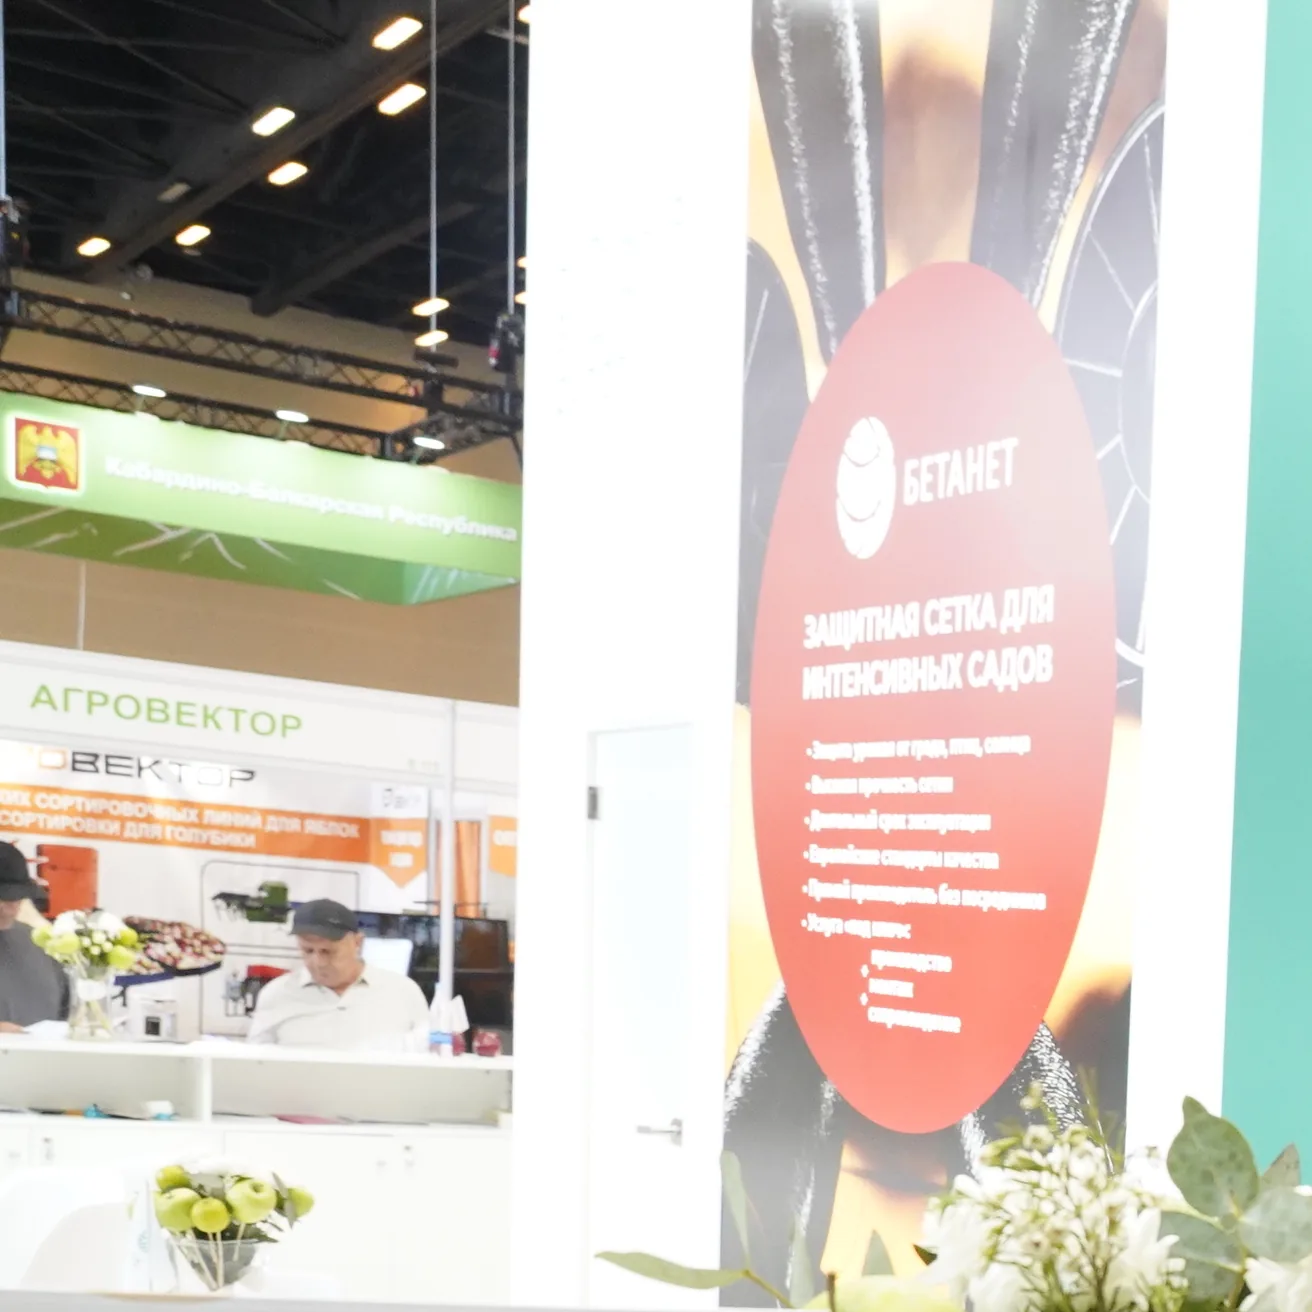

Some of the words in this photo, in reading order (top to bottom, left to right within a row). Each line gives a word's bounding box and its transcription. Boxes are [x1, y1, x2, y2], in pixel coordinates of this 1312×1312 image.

[903, 437, 1019, 505] БЕТАНЕТ
[388, 506, 518, 542] Республика
[803, 601, 920, 651] ЗАЩИТНАЯ
[923, 591, 997, 636] СЕТКА
[1000, 584, 1055, 634] ДЛЯ
[802, 652, 963, 700] ИНТЕНСИВНЫХ
[967, 644, 1054, 692] САДОВ
[30, 683, 303, 740] АГРОВЕКТОР
[123, 820, 163, 841] ДЛЯ
